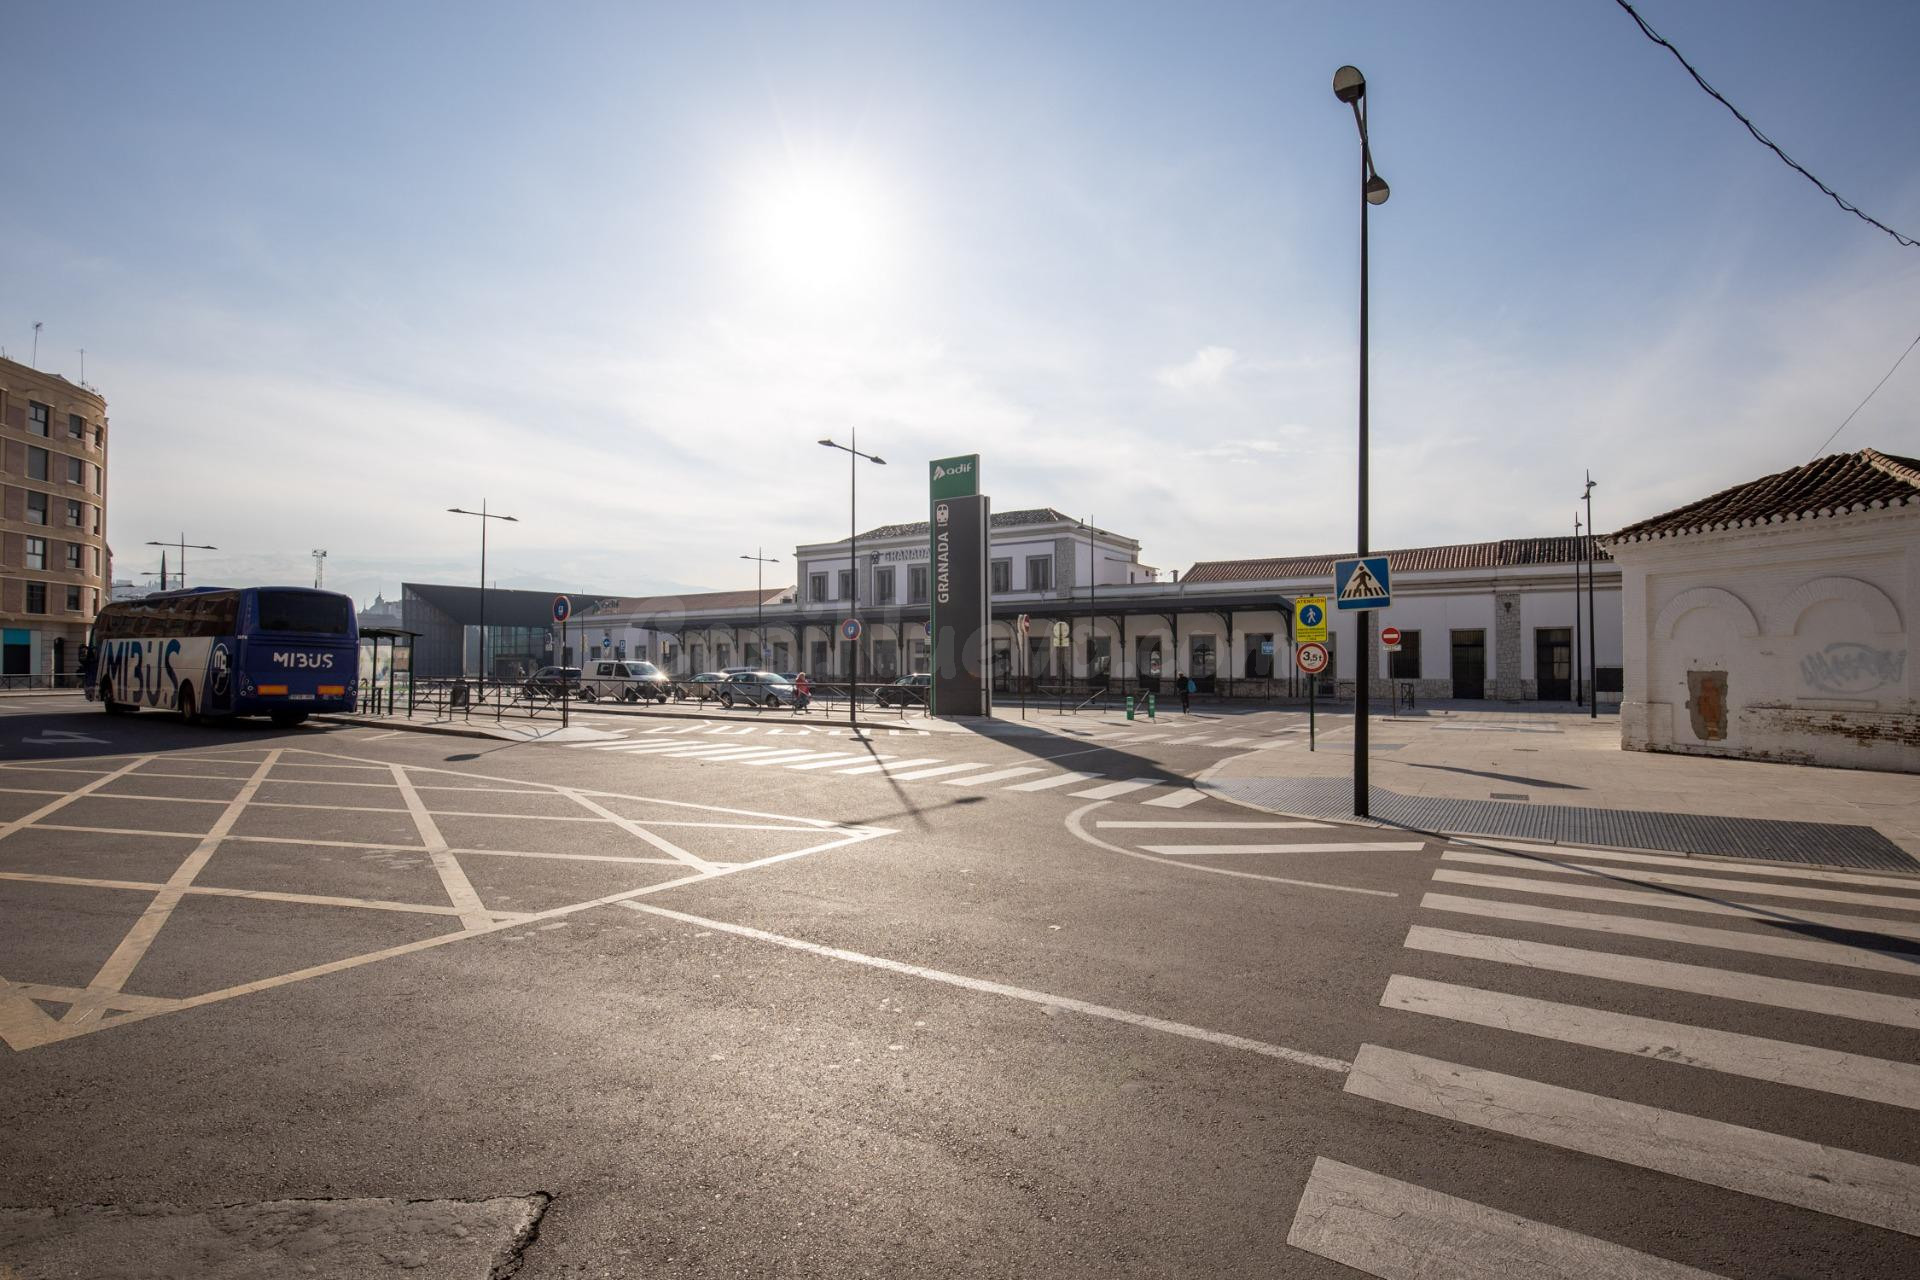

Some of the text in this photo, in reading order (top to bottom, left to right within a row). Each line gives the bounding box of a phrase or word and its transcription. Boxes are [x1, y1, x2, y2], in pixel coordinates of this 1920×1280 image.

[946, 463, 972, 475] adif
[937, 532, 949, 603] GRANADA
[107, 638, 181, 709] MIBUS
[273, 652, 334, 669] MIBUS
